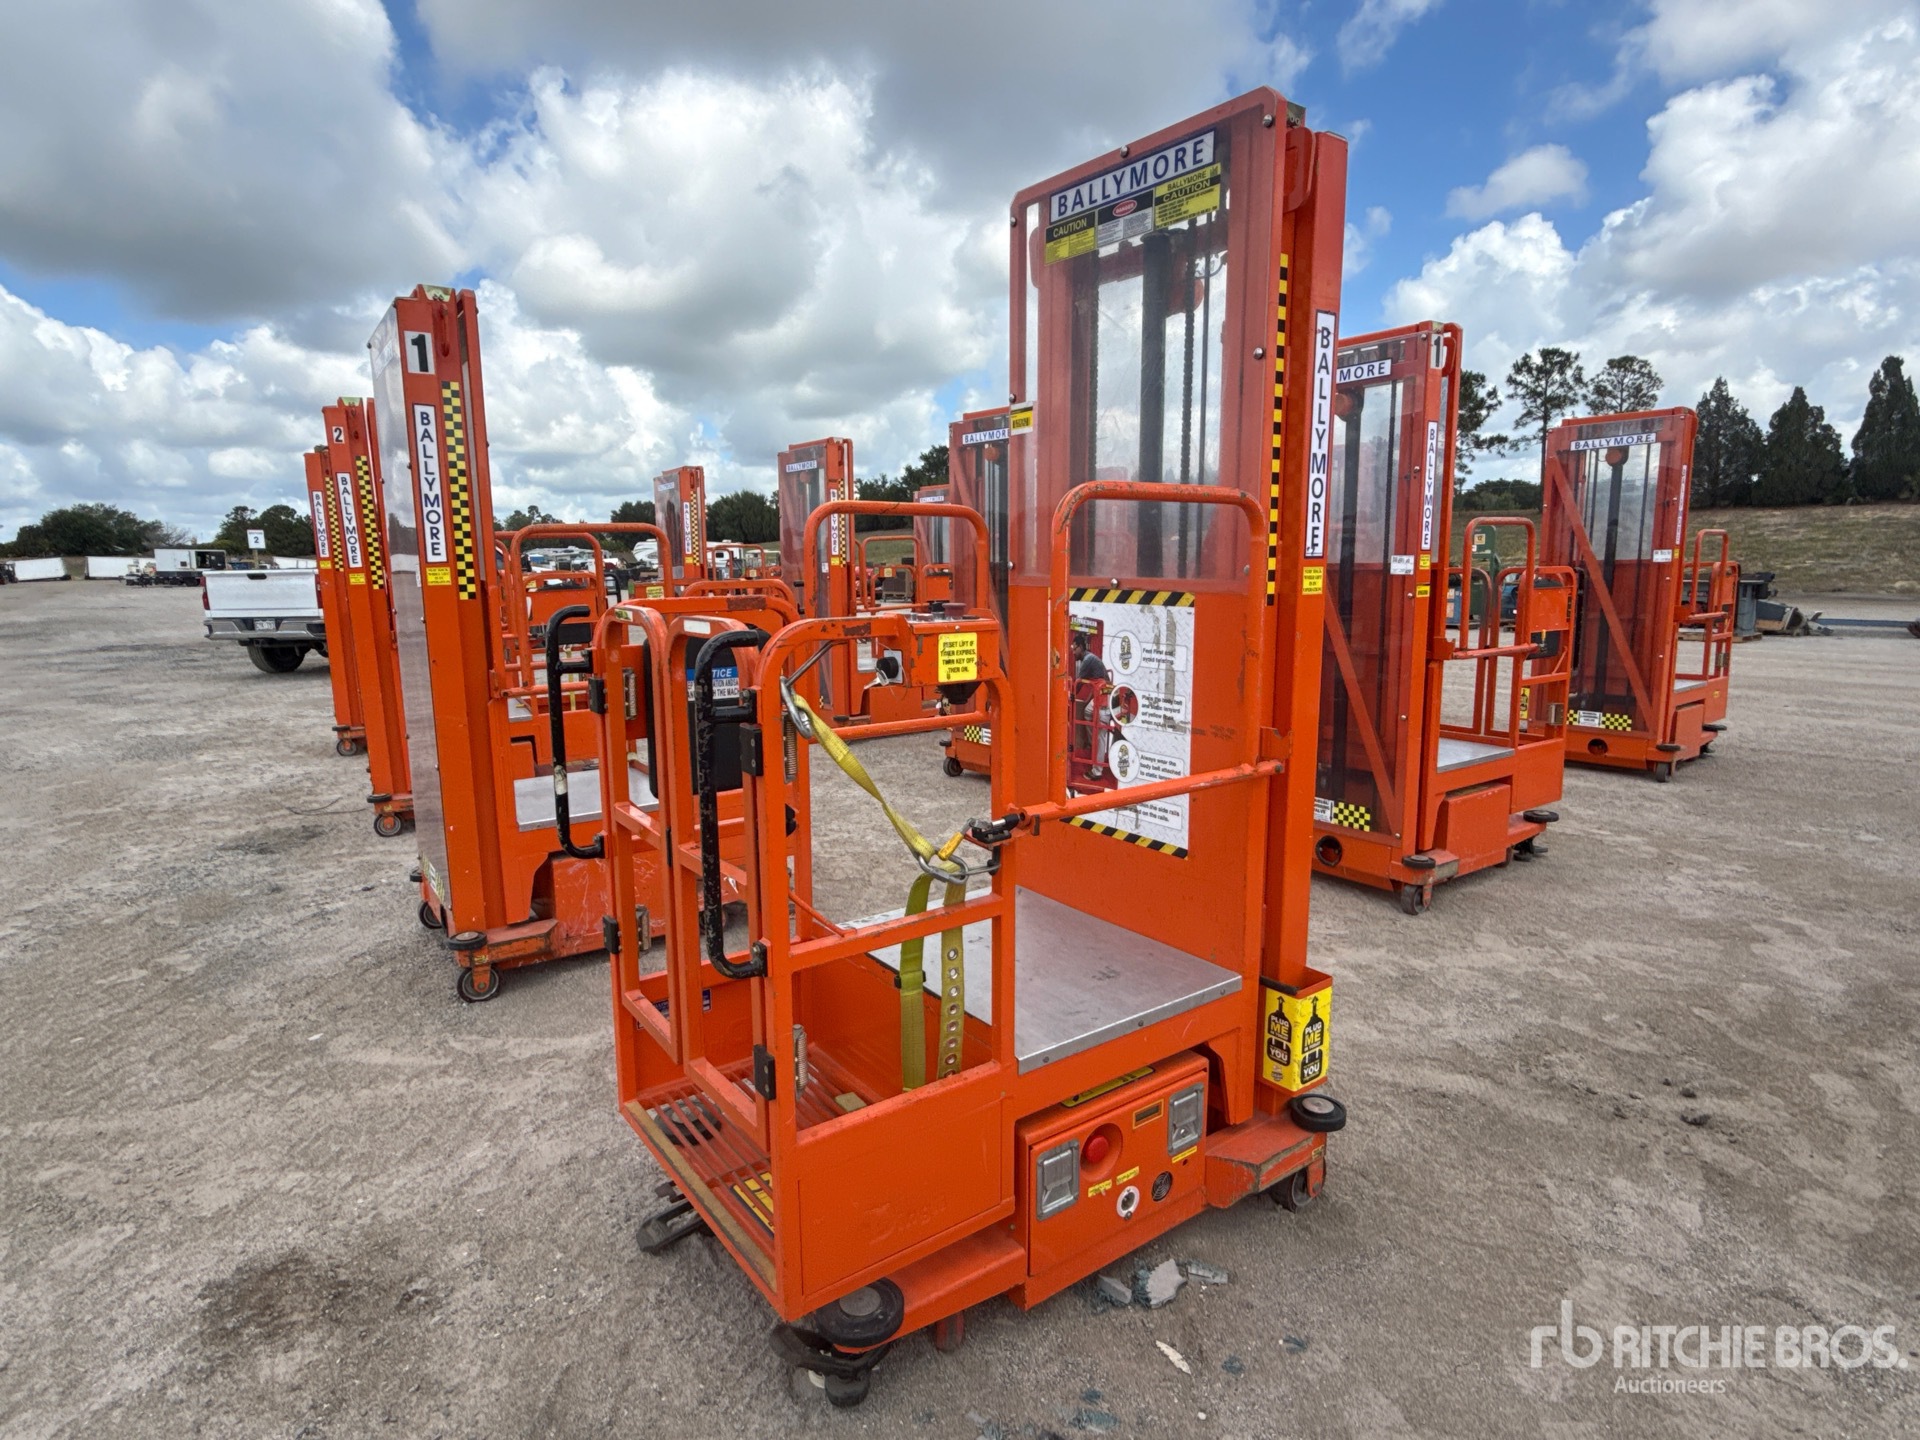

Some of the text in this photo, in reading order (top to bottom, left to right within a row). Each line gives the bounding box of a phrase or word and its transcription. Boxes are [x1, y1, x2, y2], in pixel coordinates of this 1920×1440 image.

[1057, 138, 1205, 217] BALLYMORE
[1167, 171, 1207, 191] BALLYMORE
[1163, 179, 1211, 202] CAUTION
[1053, 217, 1087, 238] CAUTION
[411, 333, 429, 372] 1
[1434, 336, 1441, 368] 1
[334, 427, 343, 443] 2
[964, 429, 1009, 443] BALLYMOR
[1311, 326, 1331, 551] BALLYMORE
[420, 412, 442, 556] BALLYMORE
[1423, 429, 1436, 547] BALLYMORE
[315, 493, 327, 556] BALLYMORE
[340, 476, 359, 565] BALLYMORE
[253, 536, 259, 544] 2
[712, 668, 732, 678] TICE
[1140, 754, 1156, 763] Always
[1158, 806, 1168, 814] side
[1169, 808, 1180, 817] rails
[1270, 1015, 1289, 1027] PLUG
[1270, 1021, 1289, 1035] ME
[1305, 1021, 1322, 1035] PLUG
[1305, 1029, 1321, 1047] ME
[1270, 1048, 1288, 1061] YOU
[1303, 1062, 1320, 1077] YOU
